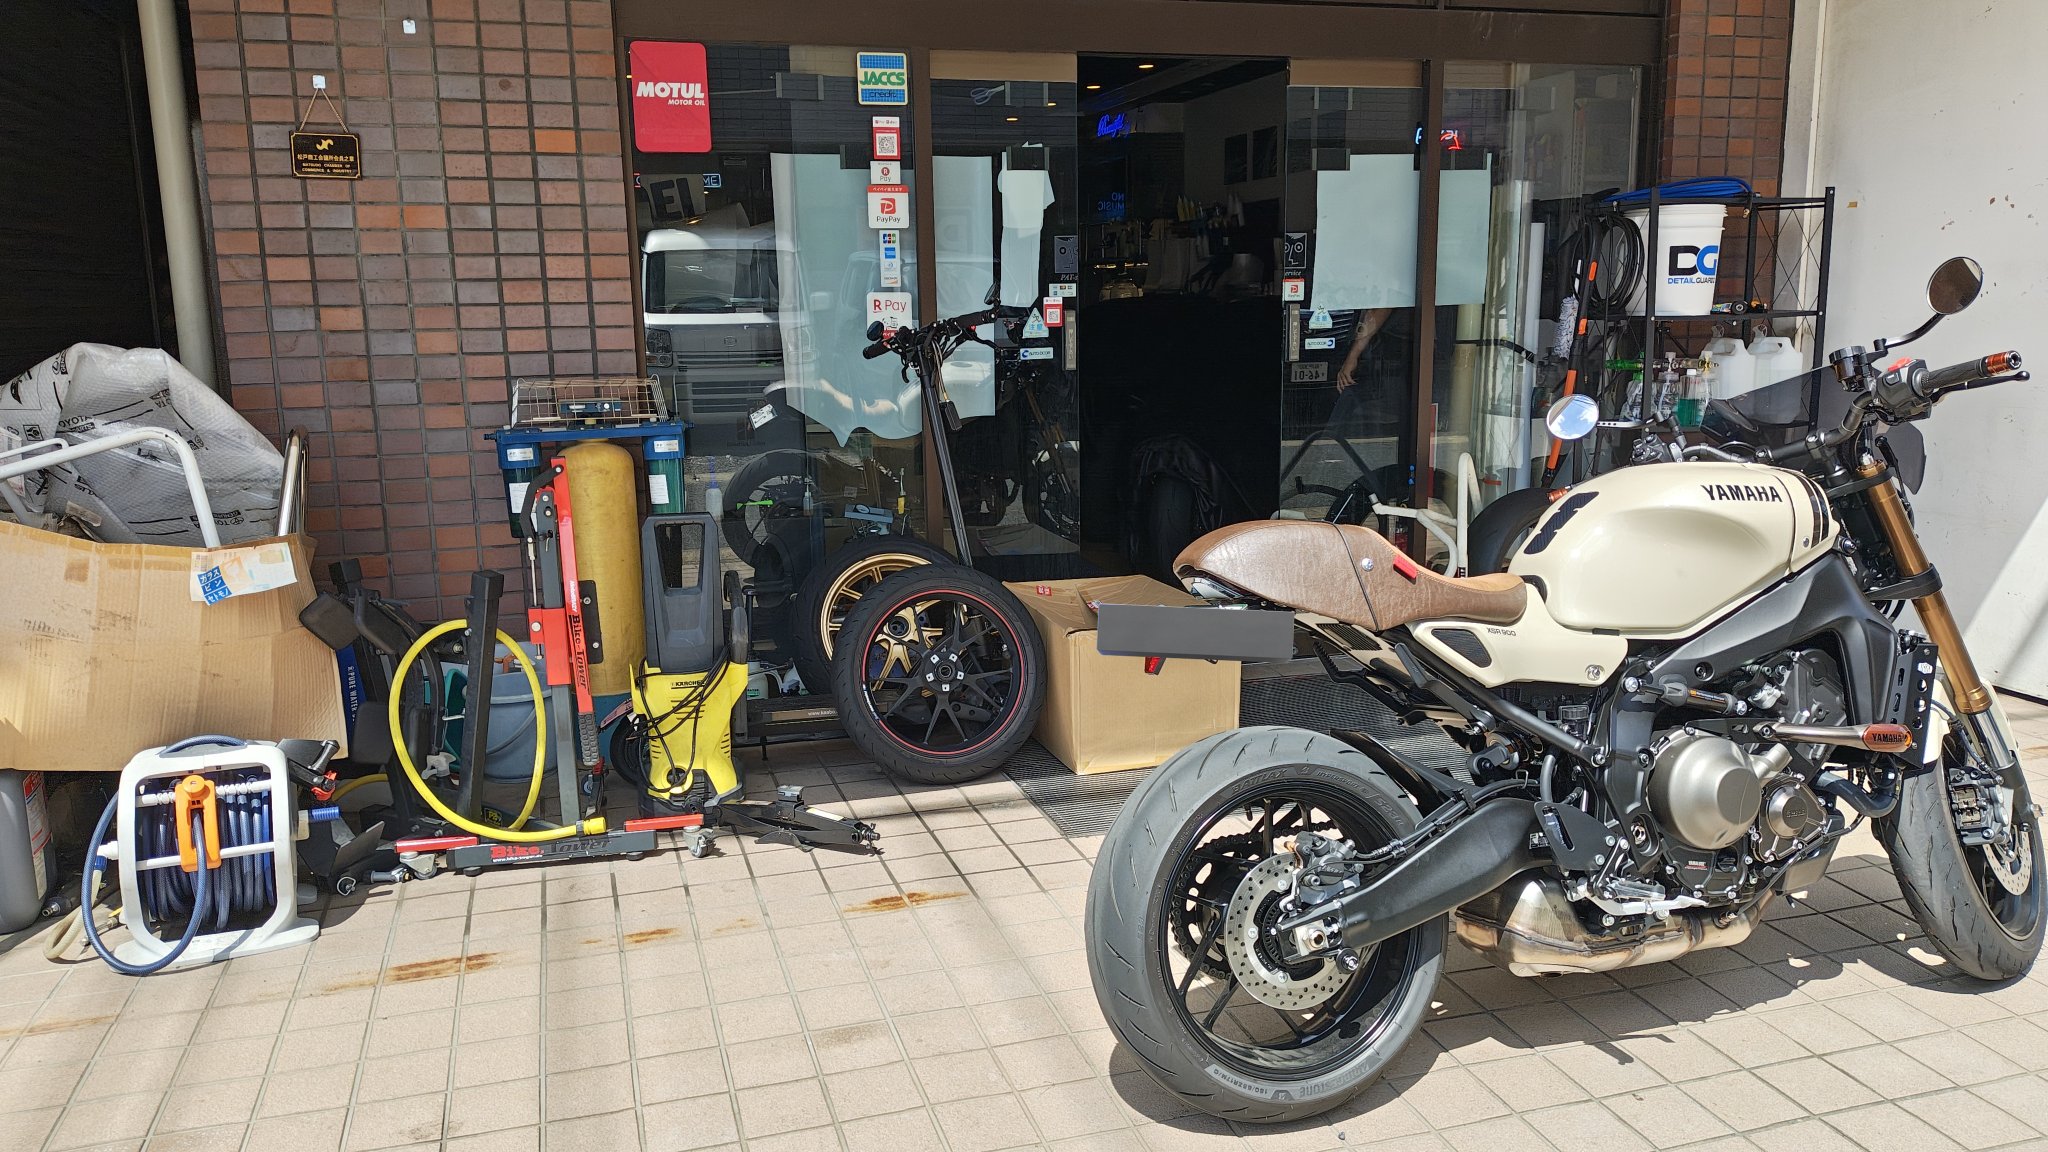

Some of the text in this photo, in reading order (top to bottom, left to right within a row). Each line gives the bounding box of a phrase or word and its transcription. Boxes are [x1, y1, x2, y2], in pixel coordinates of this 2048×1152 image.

[859, 71, 906, 86] JACCS
[636, 81, 705, 98] MOTUL
[668, 98, 693, 106] MOTOR
[876, 215, 901, 224] PayPay
[1668, 245, 1719, 276] DG
[1667, 277, 1696, 285] DETAIL
[885, 299, 907, 313] Pay
[1700, 484, 1783, 502] YAMAHA
[200, 568, 220, 583] ガラス
[1486, 627, 1517, 637] XSR 900
